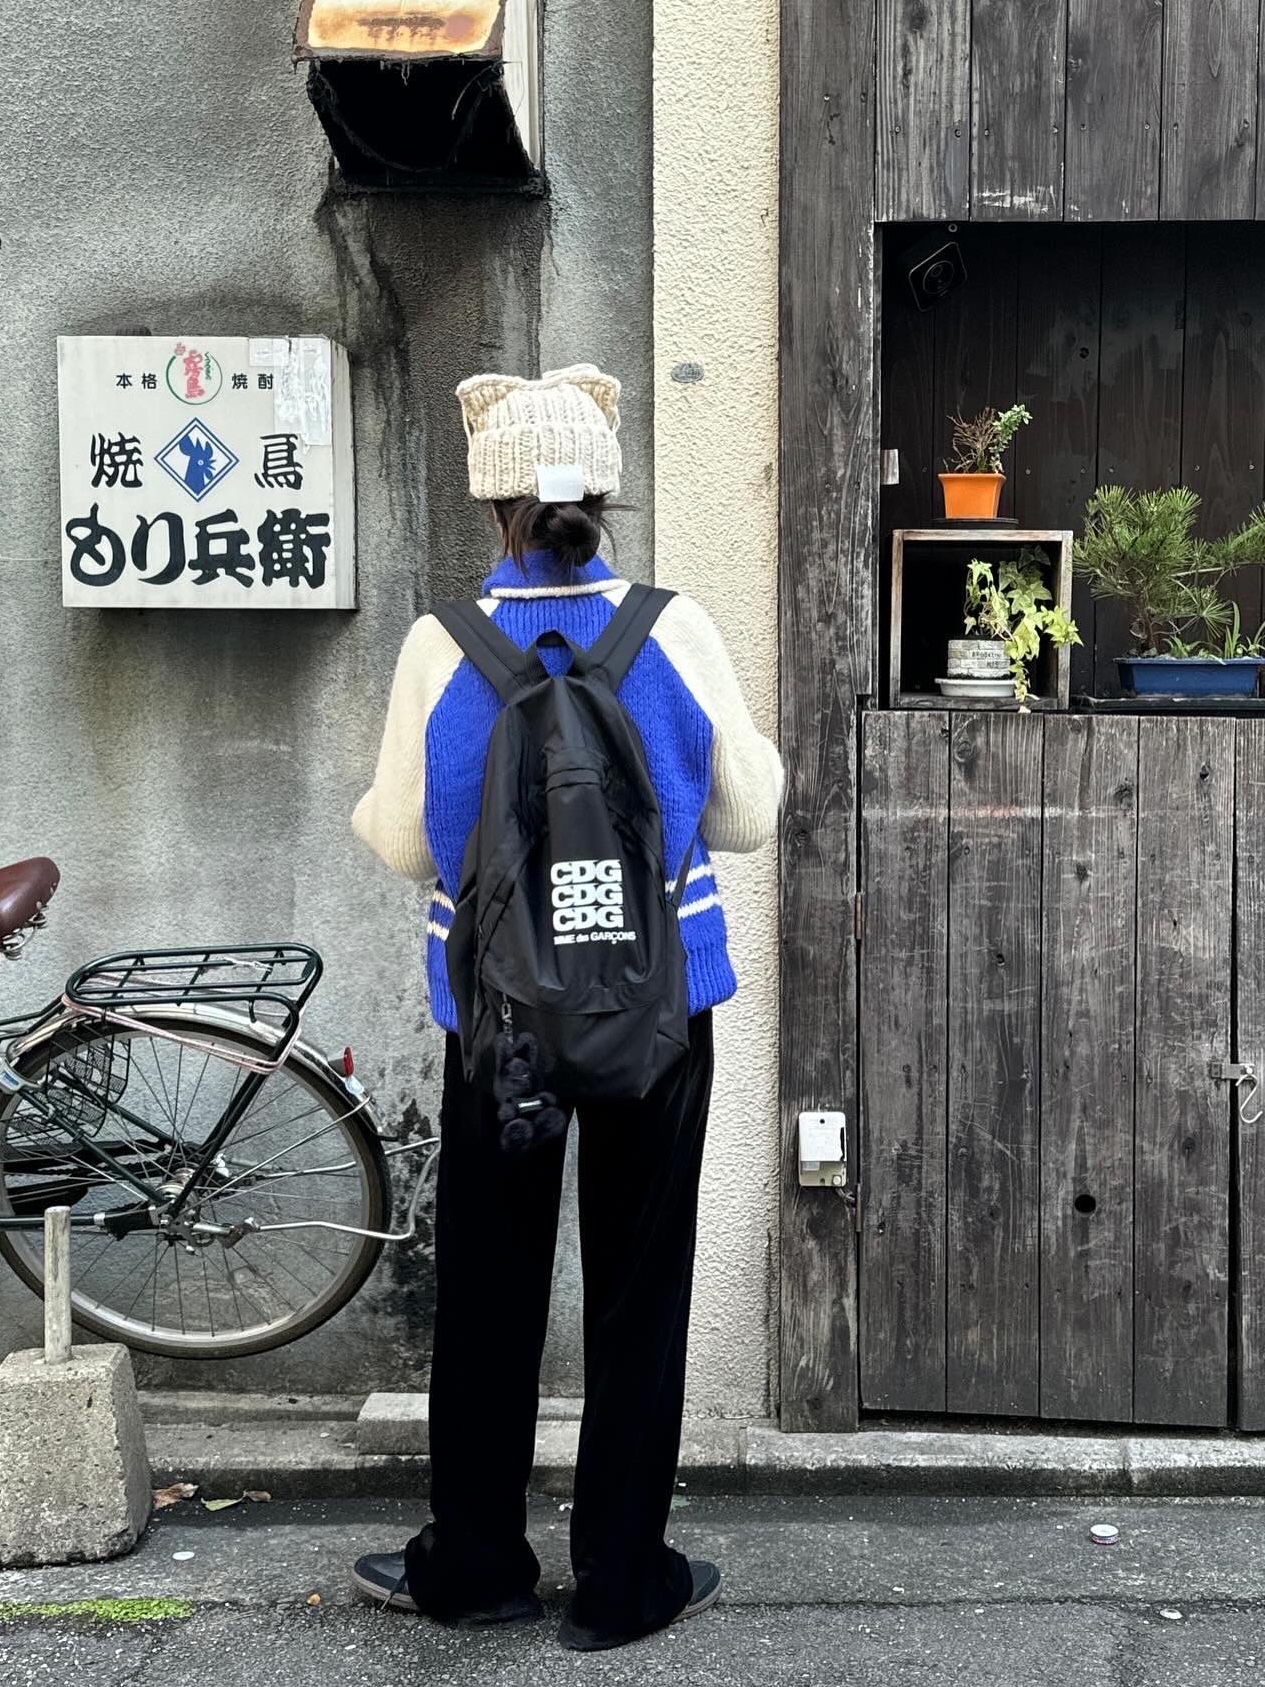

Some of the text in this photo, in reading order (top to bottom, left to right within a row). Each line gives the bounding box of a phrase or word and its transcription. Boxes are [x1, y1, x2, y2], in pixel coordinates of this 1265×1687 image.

[116, 373, 274, 390] 本格 焼酎
[550, 859, 623, 885] CDG
[551, 882, 624, 908] CDG
[552, 905, 624, 932] CDG
[590, 931, 637, 945] GARÇONS
